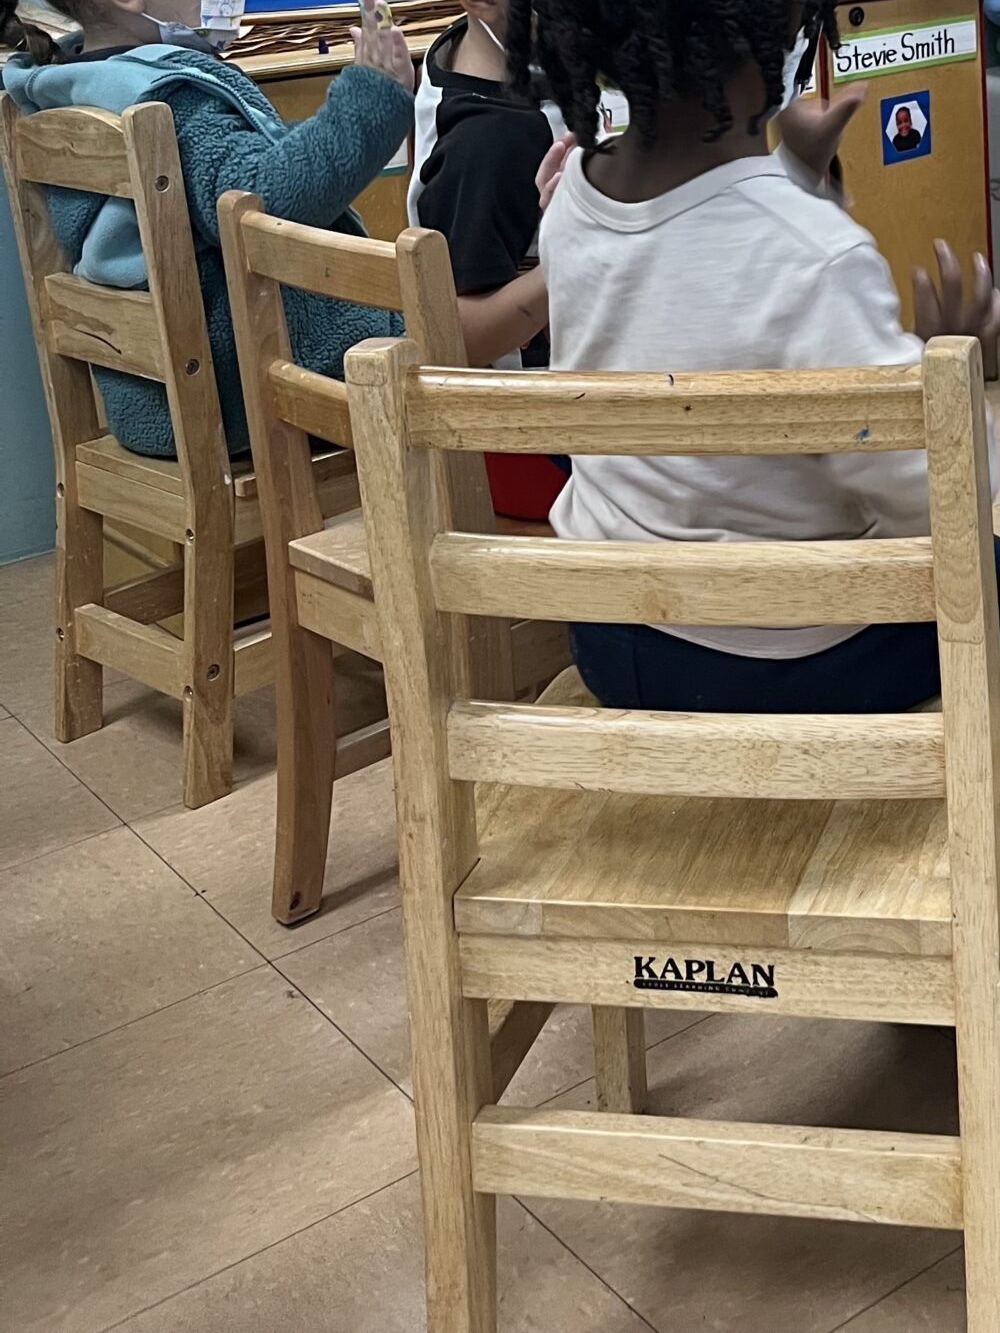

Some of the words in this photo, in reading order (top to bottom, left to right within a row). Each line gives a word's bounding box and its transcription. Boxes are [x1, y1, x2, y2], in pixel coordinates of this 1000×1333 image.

[835, 42, 897, 73] Stevie
[900, 28, 955, 62] Smith
[633, 955, 775, 988] KAPLAN
